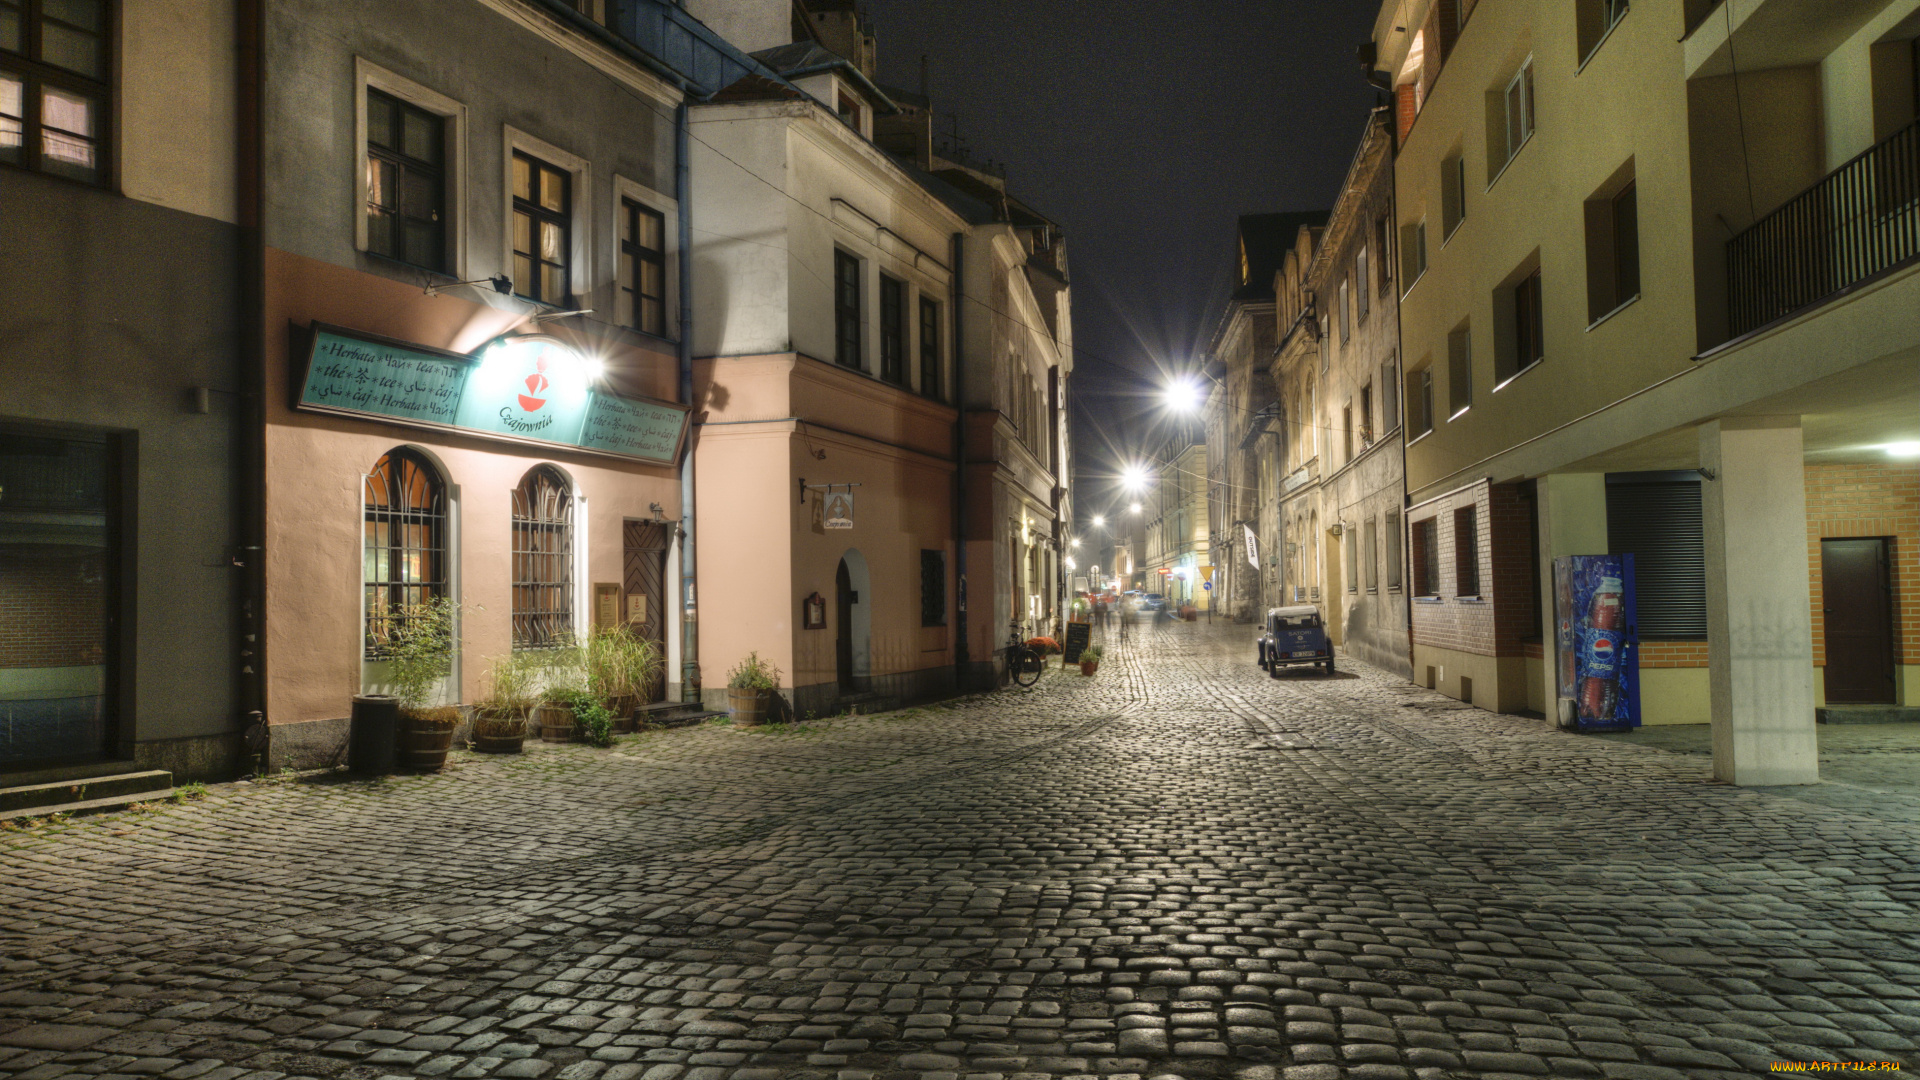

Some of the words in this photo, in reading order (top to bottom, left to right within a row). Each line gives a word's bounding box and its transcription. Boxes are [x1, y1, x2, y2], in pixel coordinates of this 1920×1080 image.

[329, 343, 376, 363] Herbata
[385, 354, 406, 368] Чай
[416, 361, 433, 373] tea
[323, 364, 346, 379] thé
[354, 367, 371, 384] 茶
[379, 376, 397, 388] tee
[404, 381, 427, 395] شاي
[435, 384, 455, 402] čaj
[318, 384, 343, 400] شاي
[352, 388, 373, 406] čaj
[380, 394, 420, 411] Herbata
[430, 402, 449, 415] Чай
[597, 399, 626, 414] Herbata
[500, 406, 552, 432] Czajownia
[626, 439, 651, 450] Herbata
[1248, 536, 1256, 558] OUTSIDE
[1588, 662, 1614, 671] PEPSI
